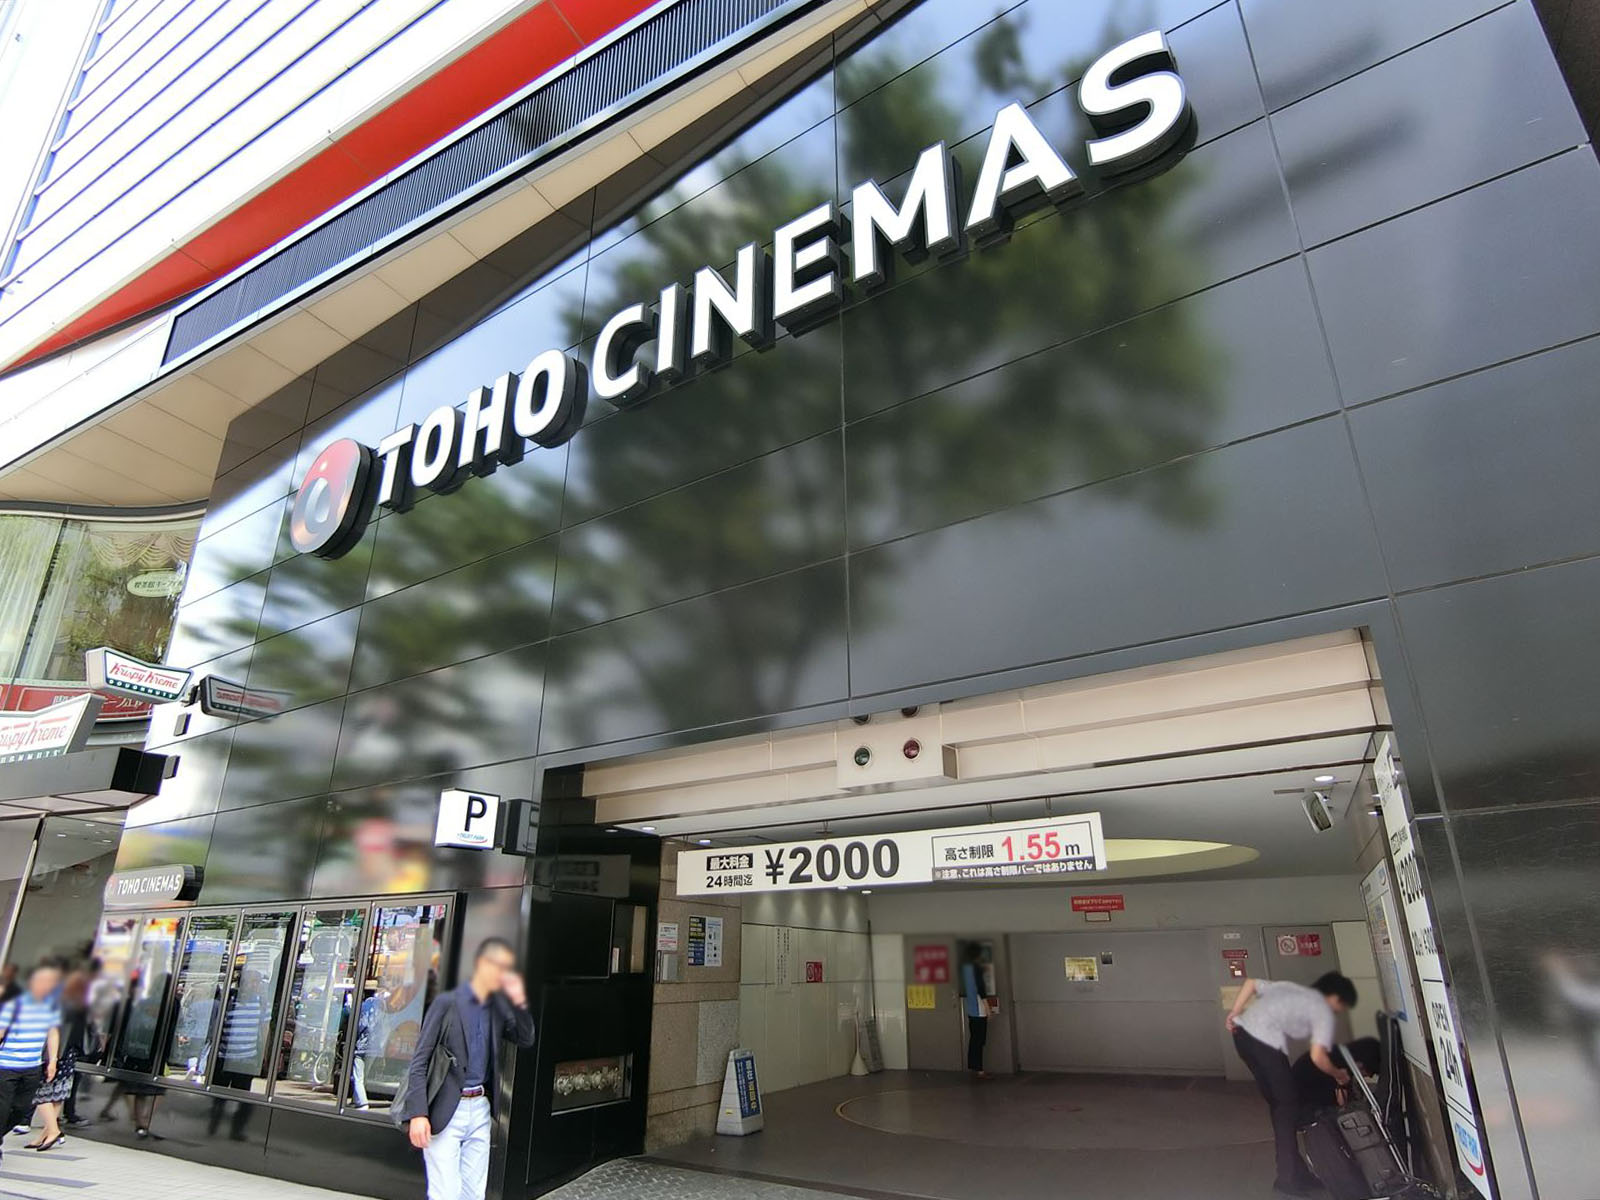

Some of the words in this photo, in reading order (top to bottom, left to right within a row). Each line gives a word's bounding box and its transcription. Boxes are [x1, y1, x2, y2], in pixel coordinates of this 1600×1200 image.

[378, 348, 567, 508] TOHO
[592, 28, 1187, 400] CINEMAS
[109, 679, 173, 698] DOUGHNUTS
[464, 795, 488, 832] P
[708, 855, 751, 869] 最大料金
[764, 838, 900, 885] ¥2000
[944, 844, 994, 862] 高さ制限
[117, 878, 141, 896] TOHO
[140, 873, 182, 893] CINEMAS
[706, 874, 753, 888] 24時間迄
